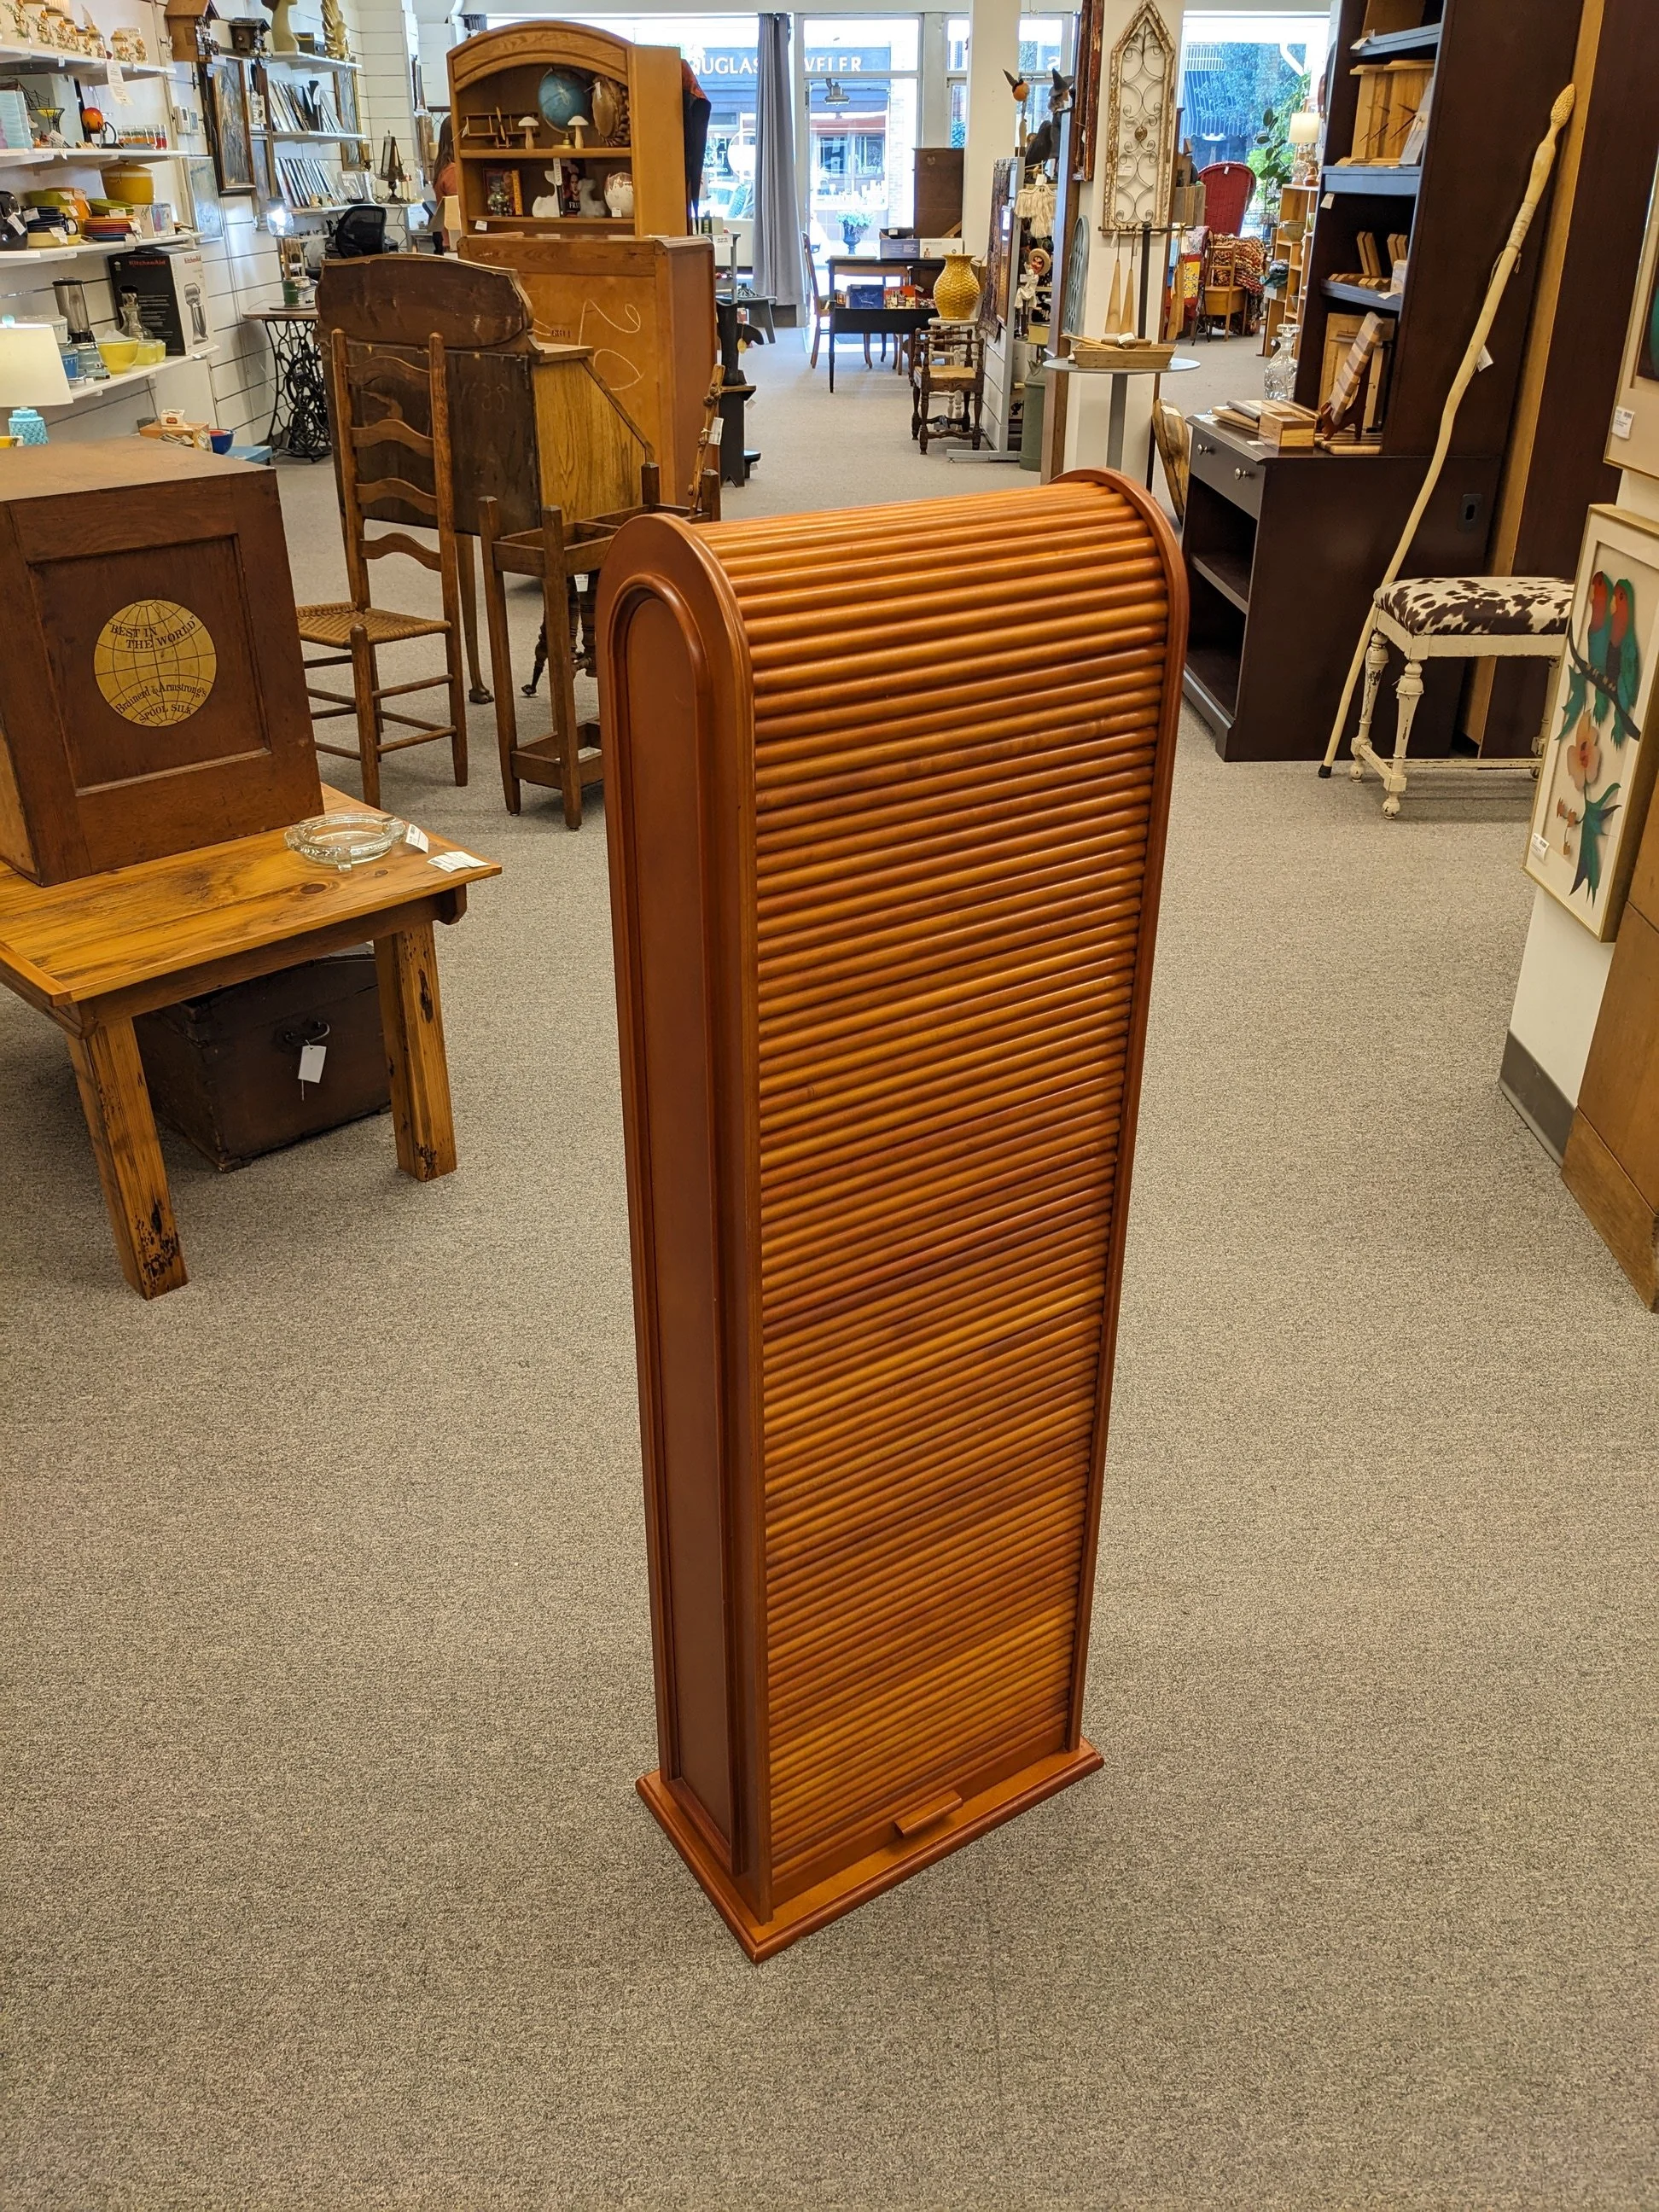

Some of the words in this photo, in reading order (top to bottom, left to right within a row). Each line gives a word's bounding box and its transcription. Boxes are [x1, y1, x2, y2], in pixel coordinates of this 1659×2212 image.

[143, 626, 158, 637] IN
[126, 639, 154, 649] THE
[115, 685, 152, 714] Brainerd
[159, 682, 207, 698] Armstrong's
[138, 705, 169, 724] SPOOL
[171, 703, 193, 715] SILK
